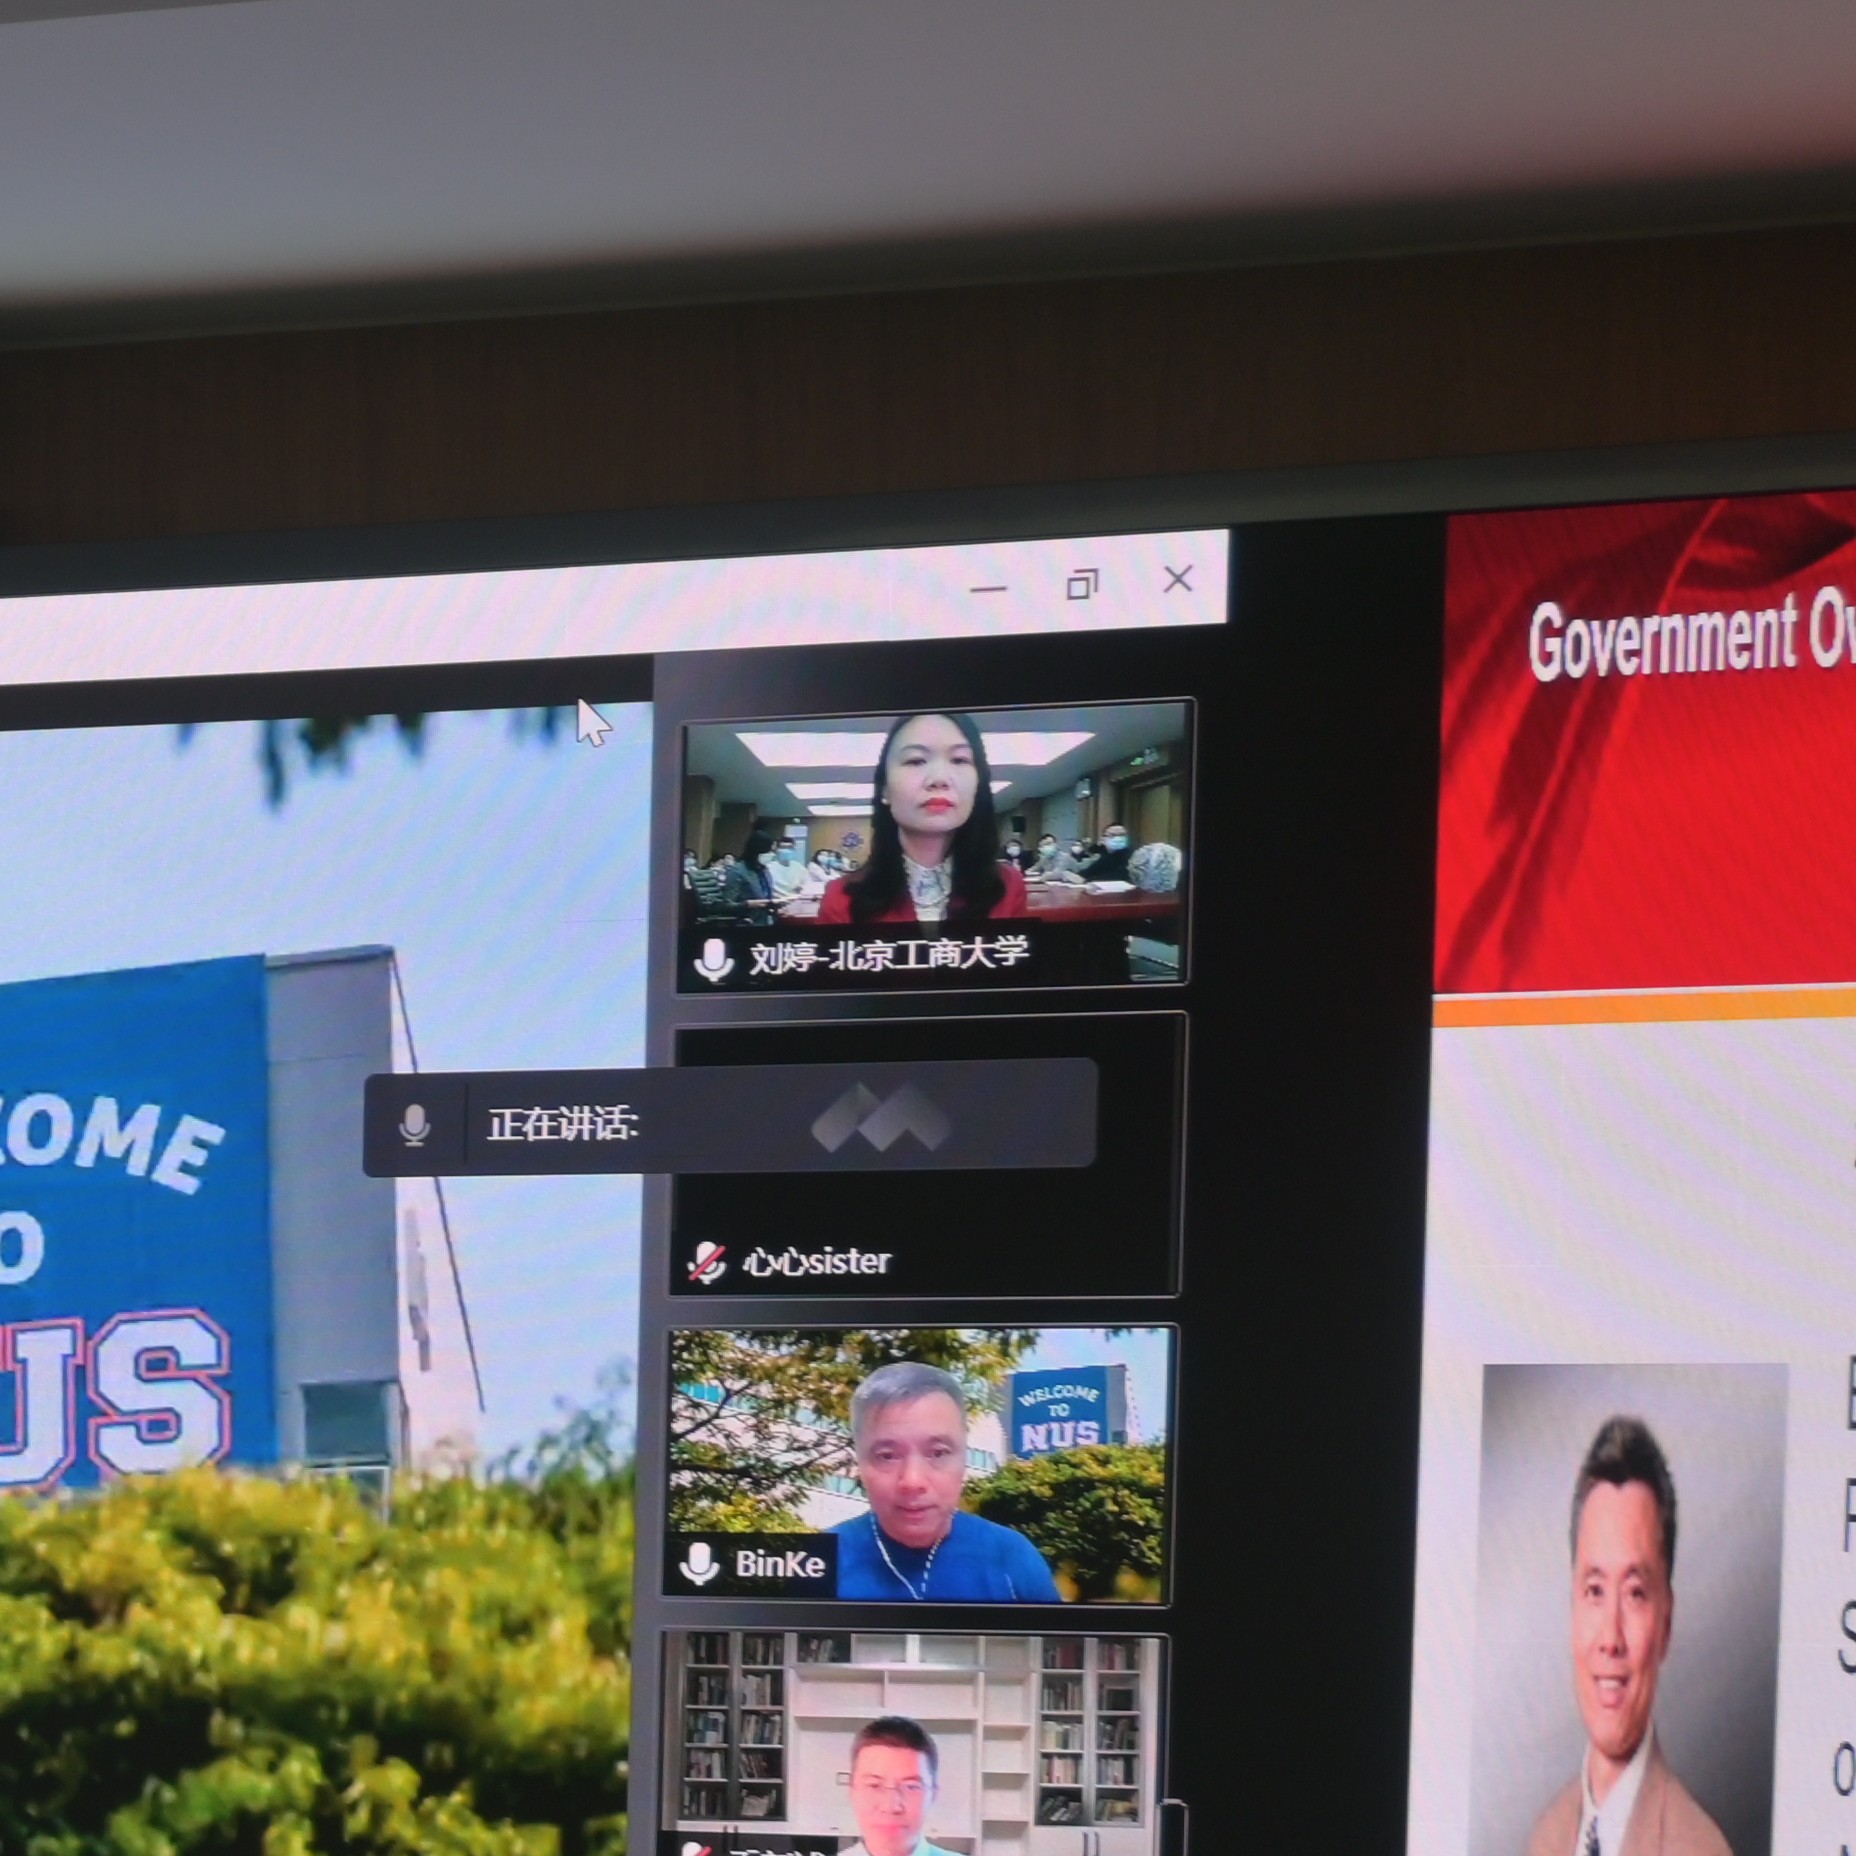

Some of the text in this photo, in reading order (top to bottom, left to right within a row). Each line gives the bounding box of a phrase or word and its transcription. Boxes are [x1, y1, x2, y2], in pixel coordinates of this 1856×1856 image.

[1529, 592, 1799, 683] Government
[749, 933, 1030, 976] 刘婷-北京工商大学
[487, 1105, 640, 1143] 正在讲话:
[742, 1246, 893, 1278] 心心sister
[1017, 1384, 1100, 1408] WELCOME
[1048, 1402, 1071, 1417] TO
[1021, 1420, 1101, 1452] NUS
[736, 1548, 826, 1580] BinKe
